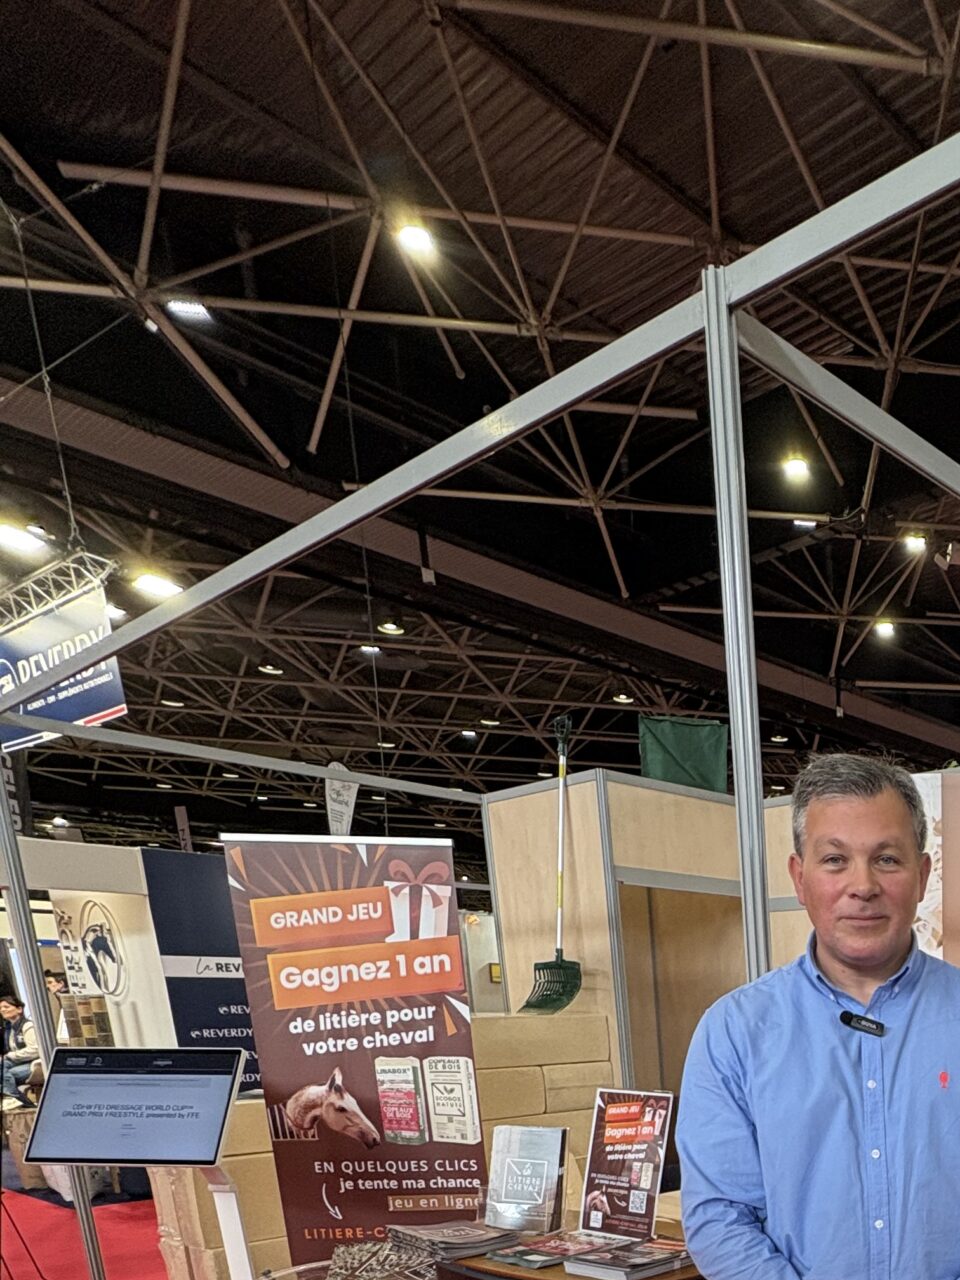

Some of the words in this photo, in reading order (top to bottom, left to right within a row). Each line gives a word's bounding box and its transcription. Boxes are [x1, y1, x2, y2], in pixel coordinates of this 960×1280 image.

[270, 906, 342, 930] GRAND
[347, 901, 382, 922] JEU
[215, 963, 242, 973] REV
[279, 960, 391, 992] Gagnez
[396, 954, 406, 976] 1
[413, 953, 451, 974] an
[230, 1005, 251, 1014] REV
[289, 1017, 315, 1034] de
[319, 1010, 382, 1030] litière
[386, 1005, 436, 1028] pour
[202, 1028, 254, 1038] REVERDY
[302, 1034, 358, 1056] votre
[363, 1025, 434, 1050] cheval
[314, 1161, 335, 1174] EN
[341, 1160, 428, 1174] QUELQUES
[434, 1159, 478, 1172] CLICS
[339, 1178, 354, 1194] je
[357, 1179, 398, 1190] tente
[402, 1178, 426, 1188] ma
[429, 1177, 481, 1189] chance
[388, 1196, 414, 1210] jeu
[419, 1197, 438, 1208] en
[304, 1227, 386, 1240] LITIERE-C
